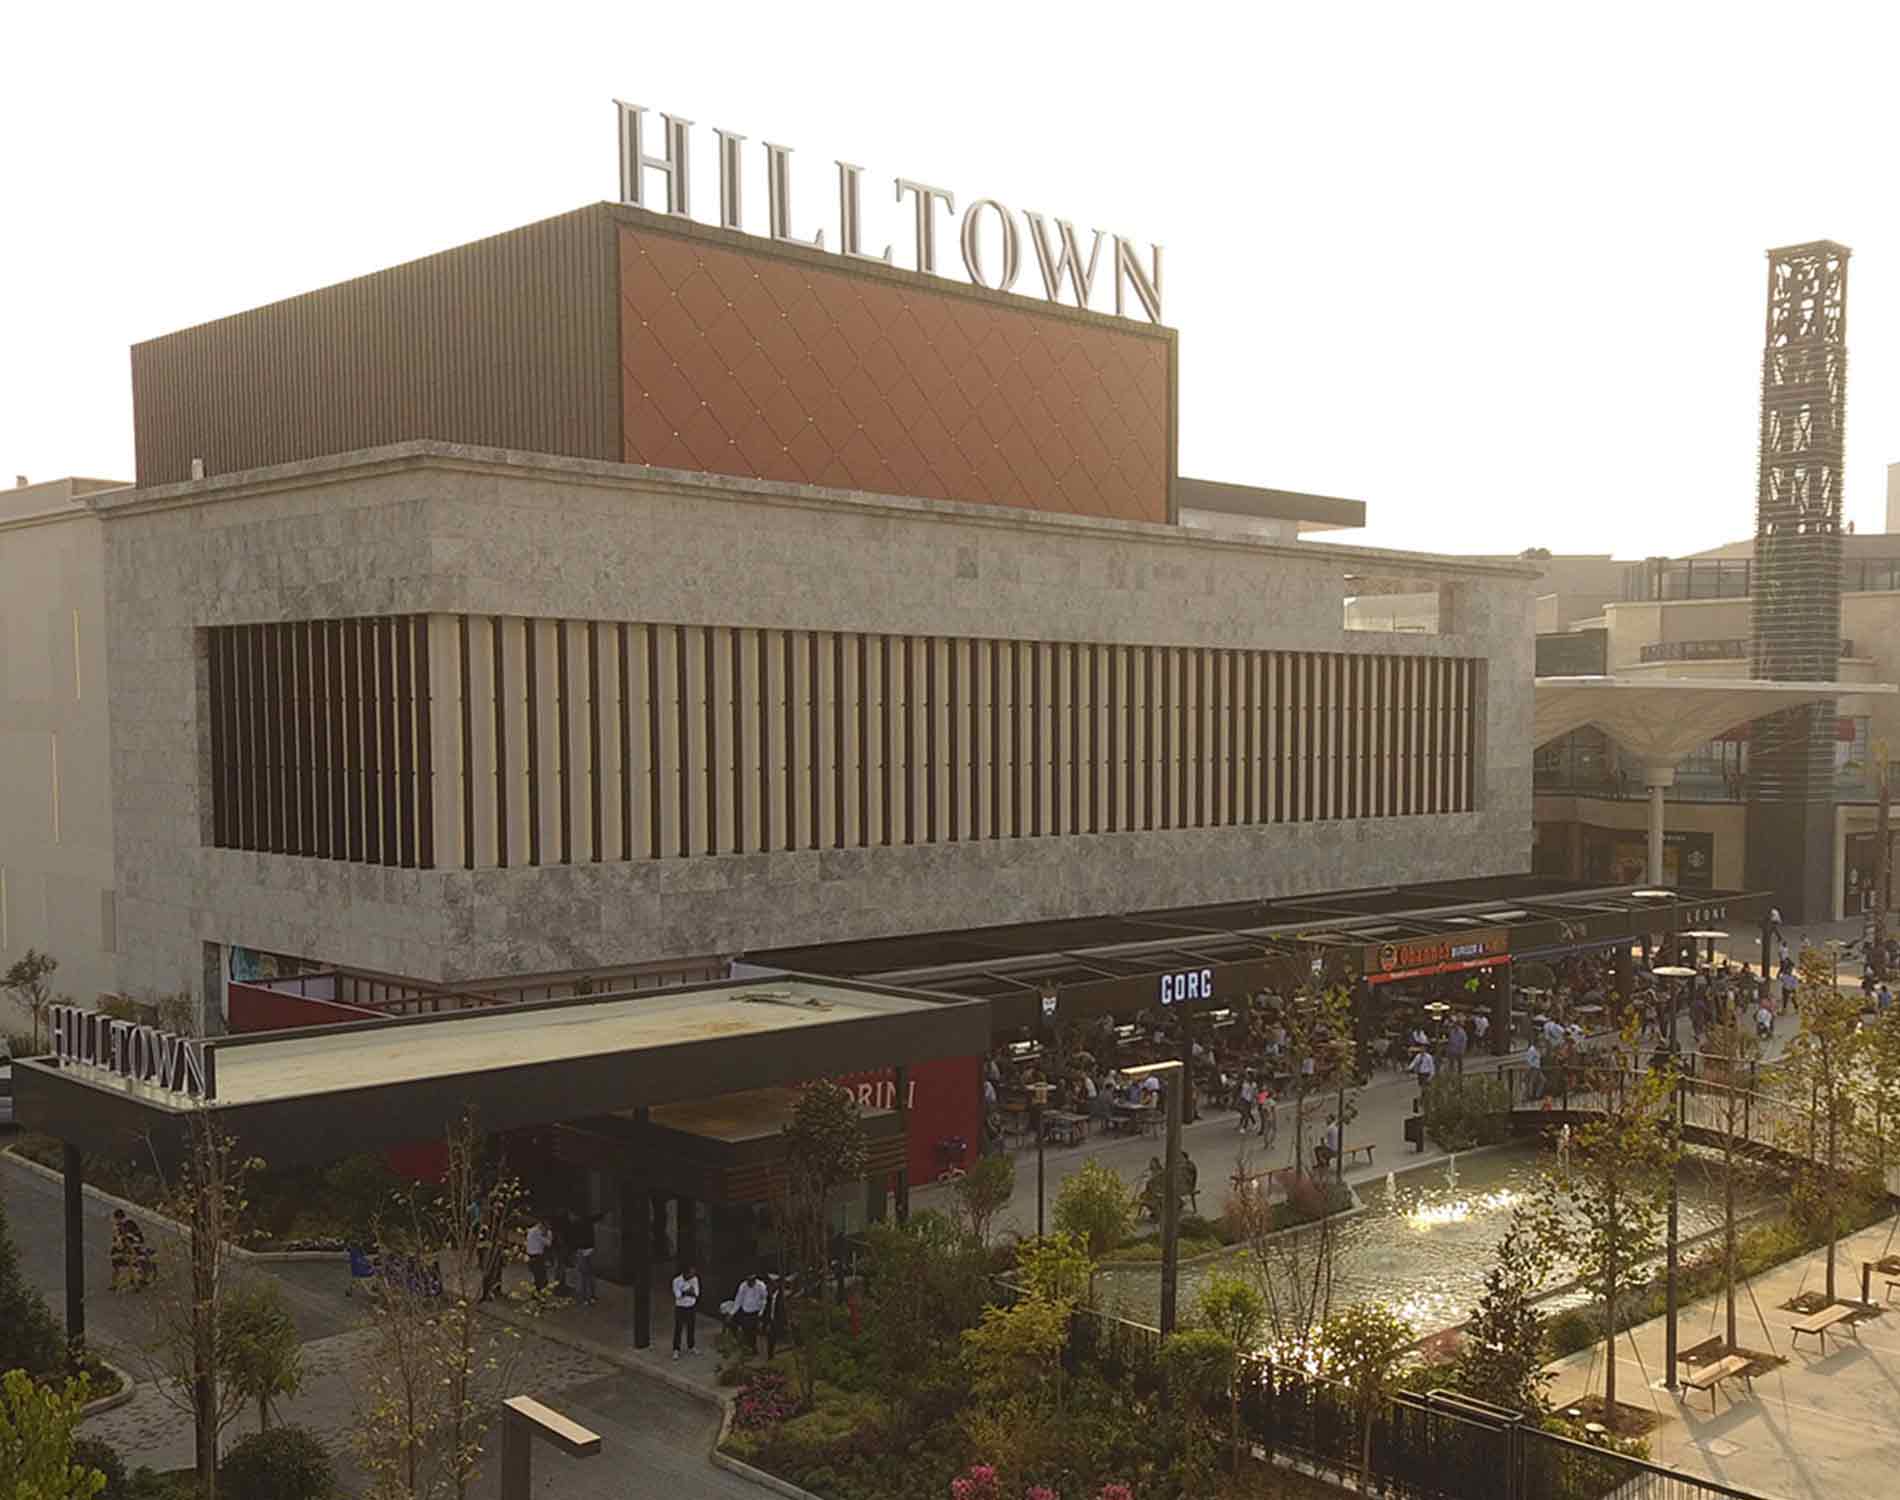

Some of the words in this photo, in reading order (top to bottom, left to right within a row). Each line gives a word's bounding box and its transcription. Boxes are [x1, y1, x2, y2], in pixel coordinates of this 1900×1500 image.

[611, 98, 1166, 325] HILLTOWN
[1160, 968, 1212, 1005] GORG
[49, 1003, 216, 1100] HILLTOWN
